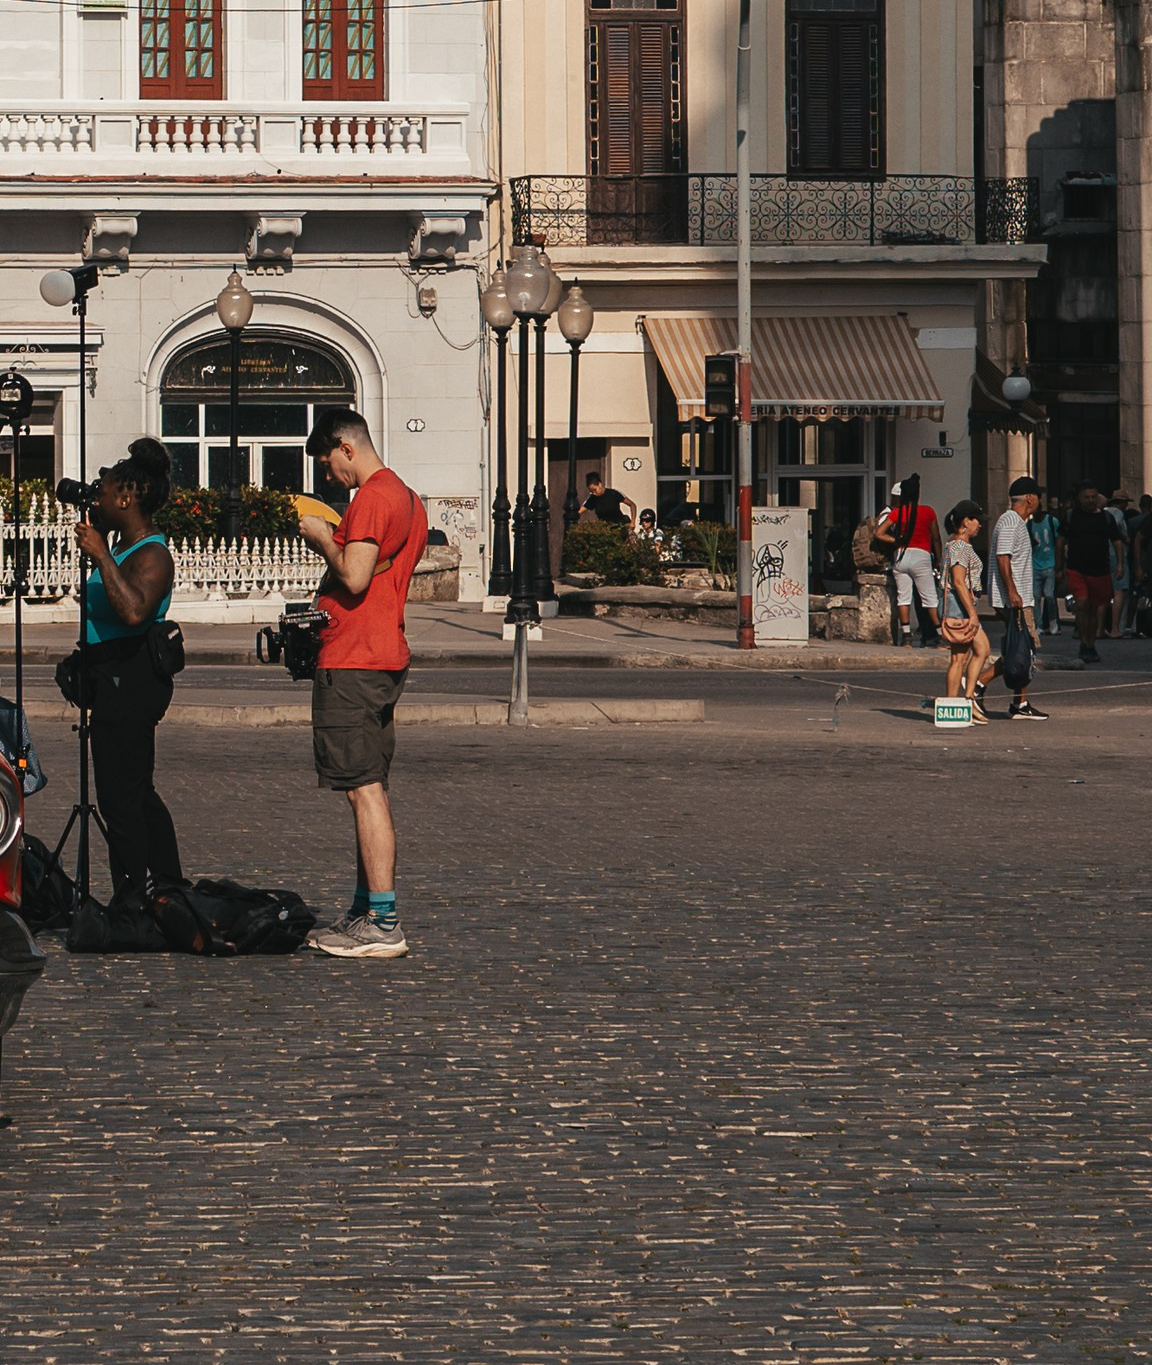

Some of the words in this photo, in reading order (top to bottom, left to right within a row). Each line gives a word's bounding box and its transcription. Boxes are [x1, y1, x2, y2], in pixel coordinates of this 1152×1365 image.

[781, 405, 827, 416] ATENEO
[833, 405, 901, 416] CERVANTES
[937, 707, 970, 719] SALIDA
